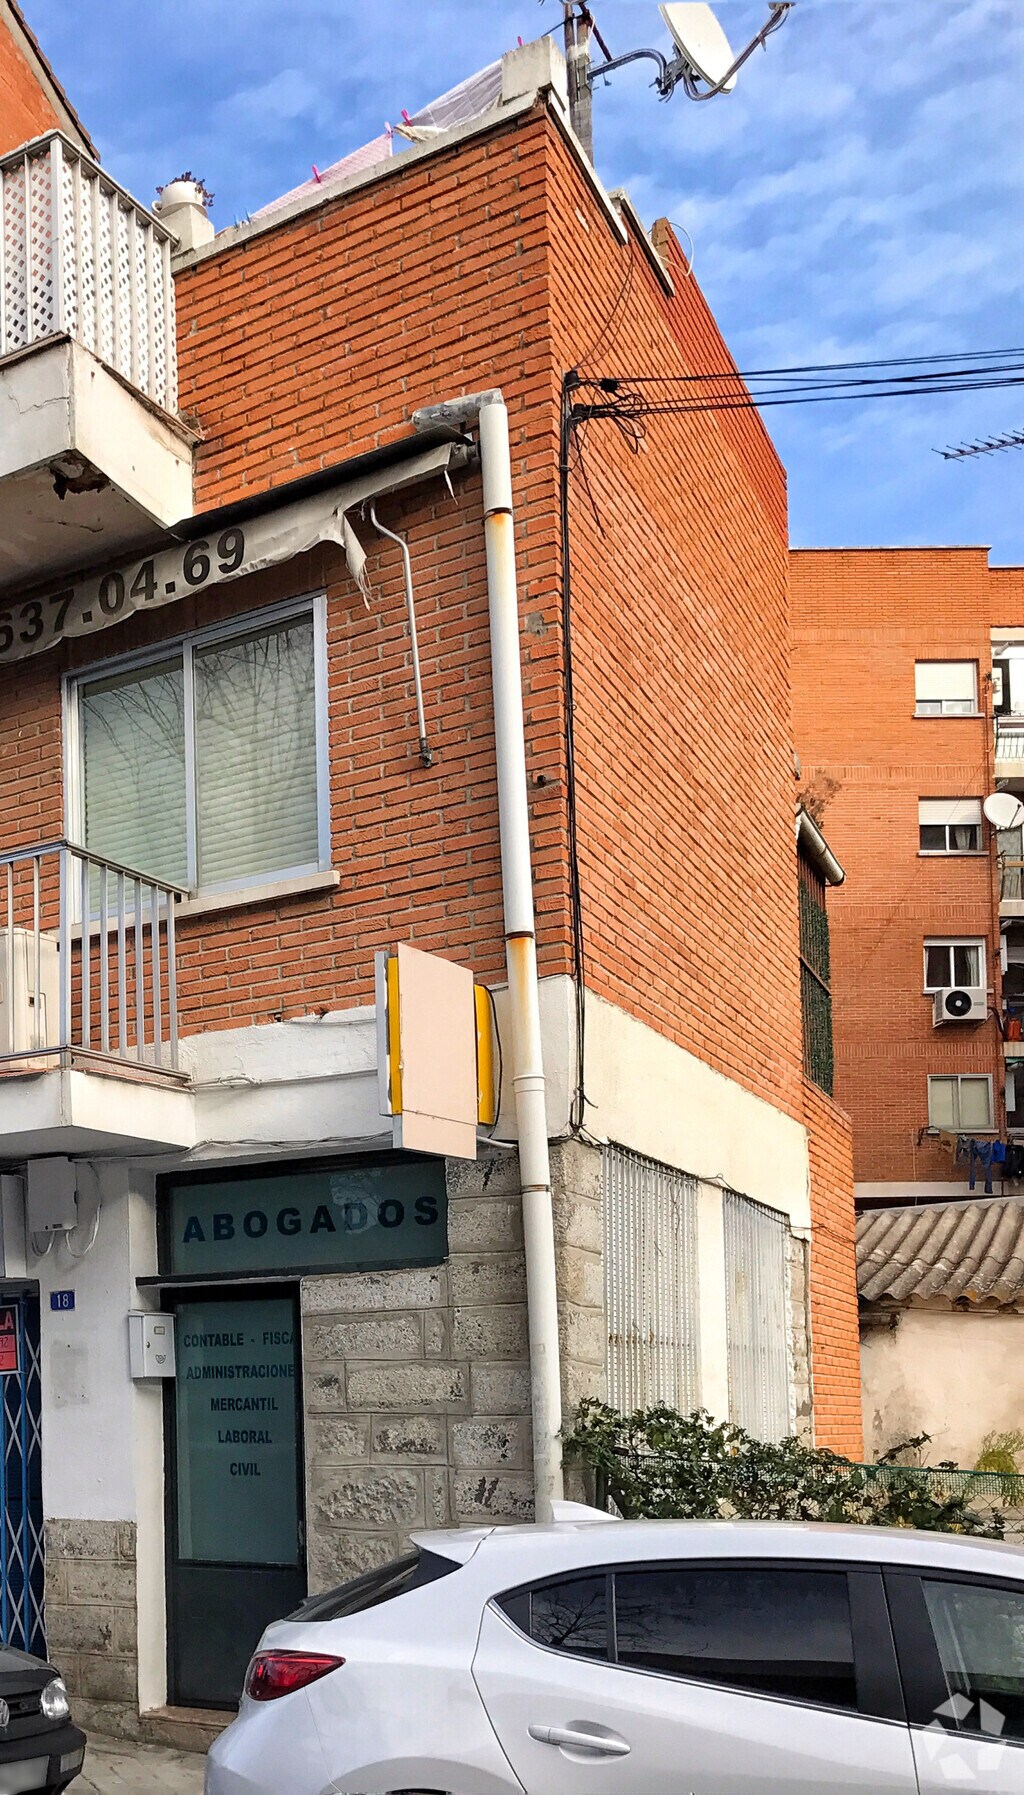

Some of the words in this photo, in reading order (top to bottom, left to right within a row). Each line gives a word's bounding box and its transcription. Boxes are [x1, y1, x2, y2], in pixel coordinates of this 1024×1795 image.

[182, 1196, 439, 1243] ABOGADOS
[56, 1293, 69, 1308] 18
[183, 1333, 244, 1347] CONTABLE
[210, 1397, 279, 1412] MERCANTIL
[218, 1430, 273, 1444] LABORAL
[230, 1462, 261, 1476] CIVIL
